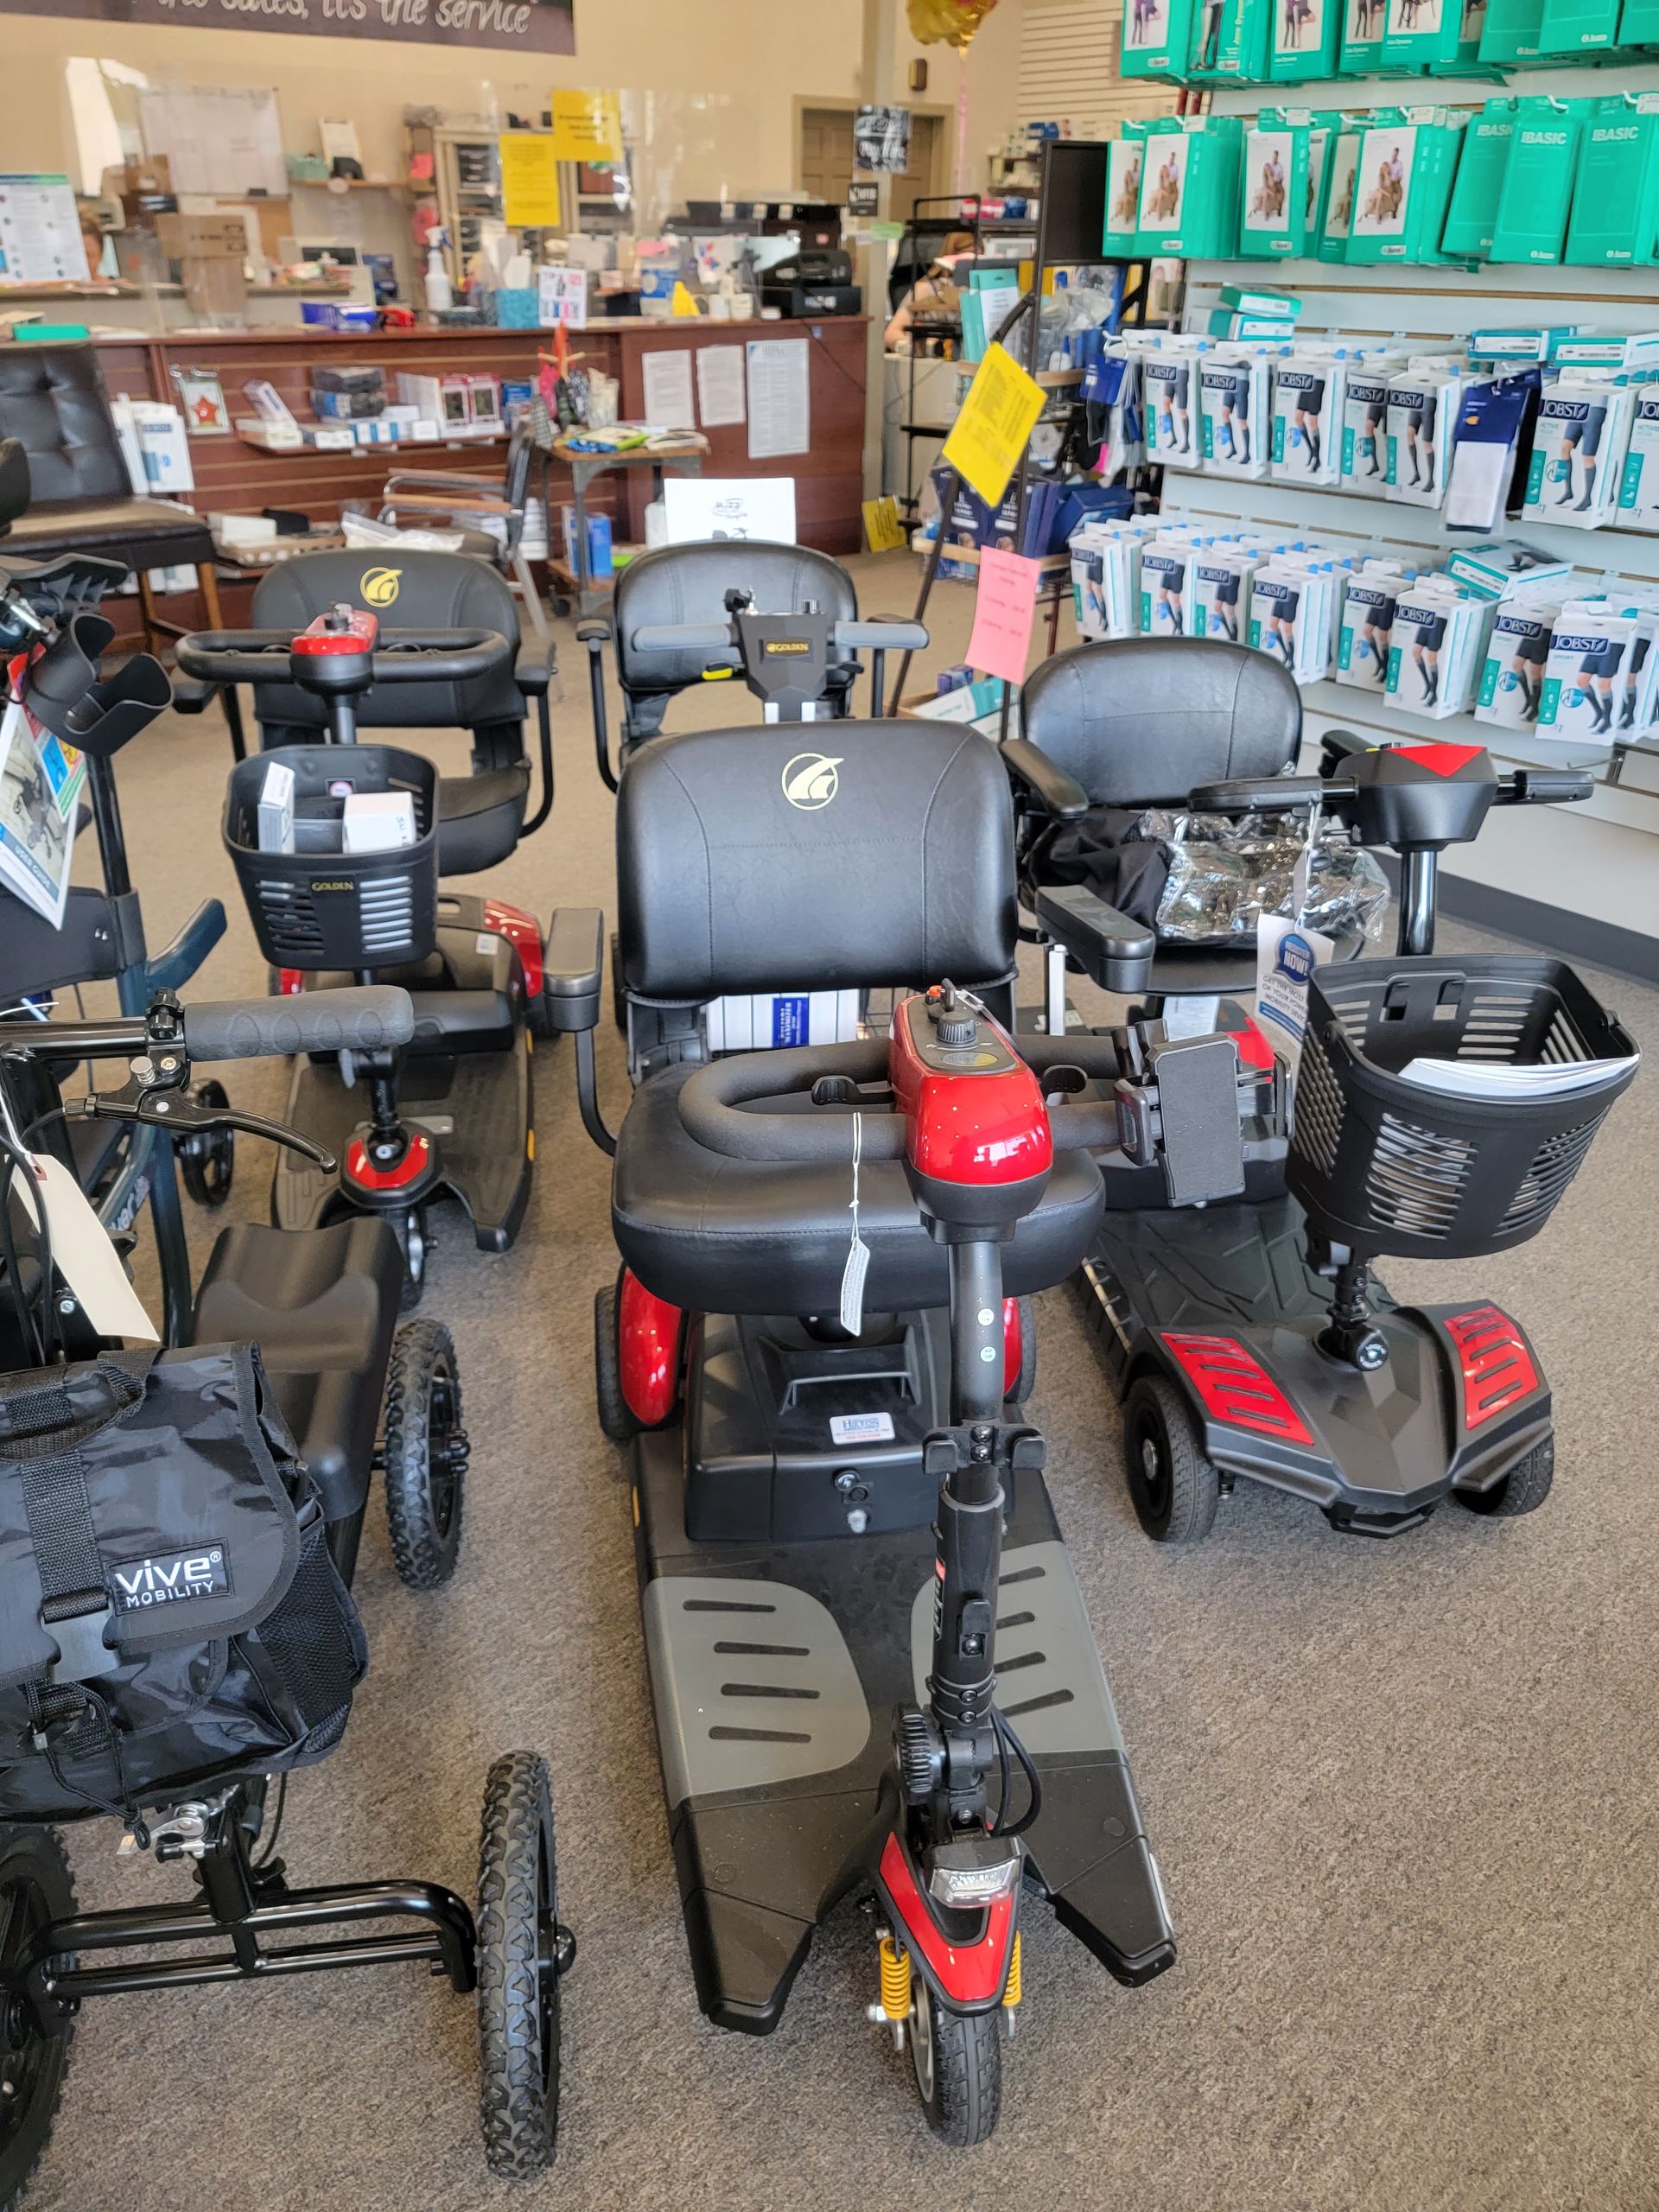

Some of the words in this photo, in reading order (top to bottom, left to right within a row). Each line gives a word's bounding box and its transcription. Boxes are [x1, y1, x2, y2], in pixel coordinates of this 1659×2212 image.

[322, 0, 367, 20] its
[378, 0, 427, 26] the
[435, 0, 531, 34] service
[1203, 372, 1230, 389] JOBST
[1280, 372, 1306, 389] JOBST
[1349, 384, 1377, 402] JOBST
[1389, 390, 1417, 406] JOBST
[1541, 399, 1581, 417] JOBST
[1349, 587, 1378, 604] JOBST
[1398, 604, 1427, 624] JOBST
[1497, 615, 1534, 635] JOBST
[775, 643, 809, 652] GOLDEN
[1554, 634, 1598, 651] JOBST
[311, 881, 354, 892] GOLDEN
[1283, 950, 1309, 976] NOW!
[126, 1580, 214, 1609] MOBILITY
